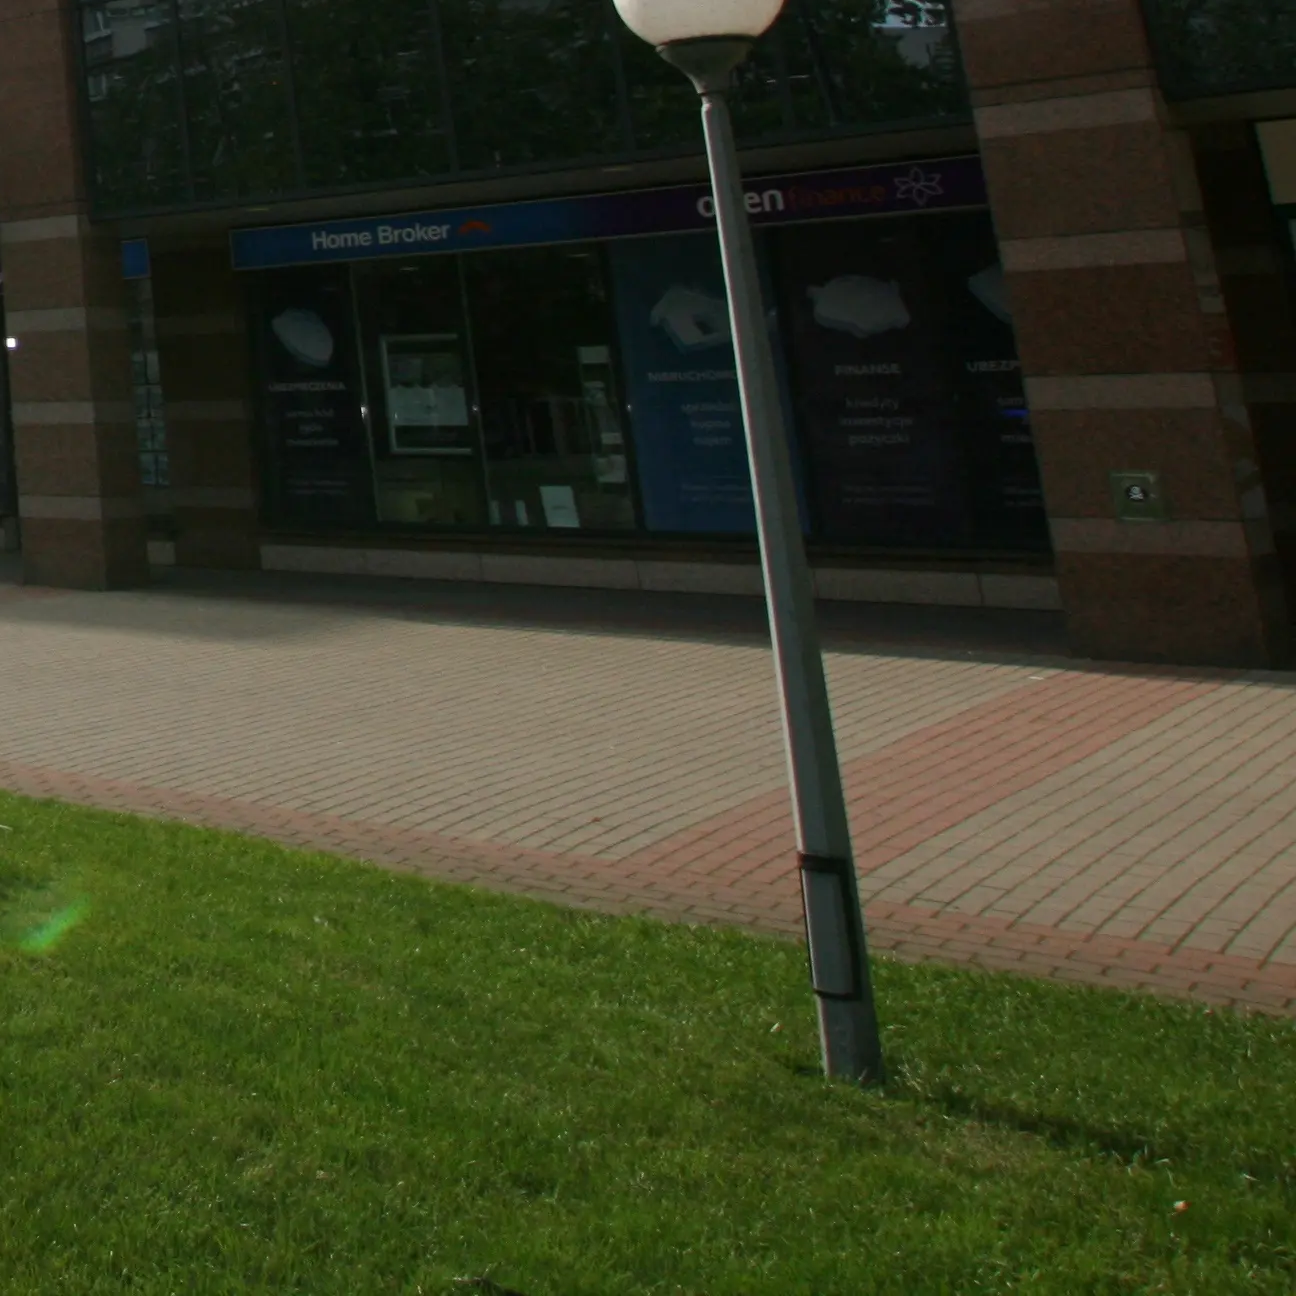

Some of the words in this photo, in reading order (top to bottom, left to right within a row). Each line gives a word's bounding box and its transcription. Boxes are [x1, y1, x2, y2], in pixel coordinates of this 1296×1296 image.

[696, 186, 785, 218] oen
[311, 231, 373, 251] Home
[377, 223, 450, 244] Broker
